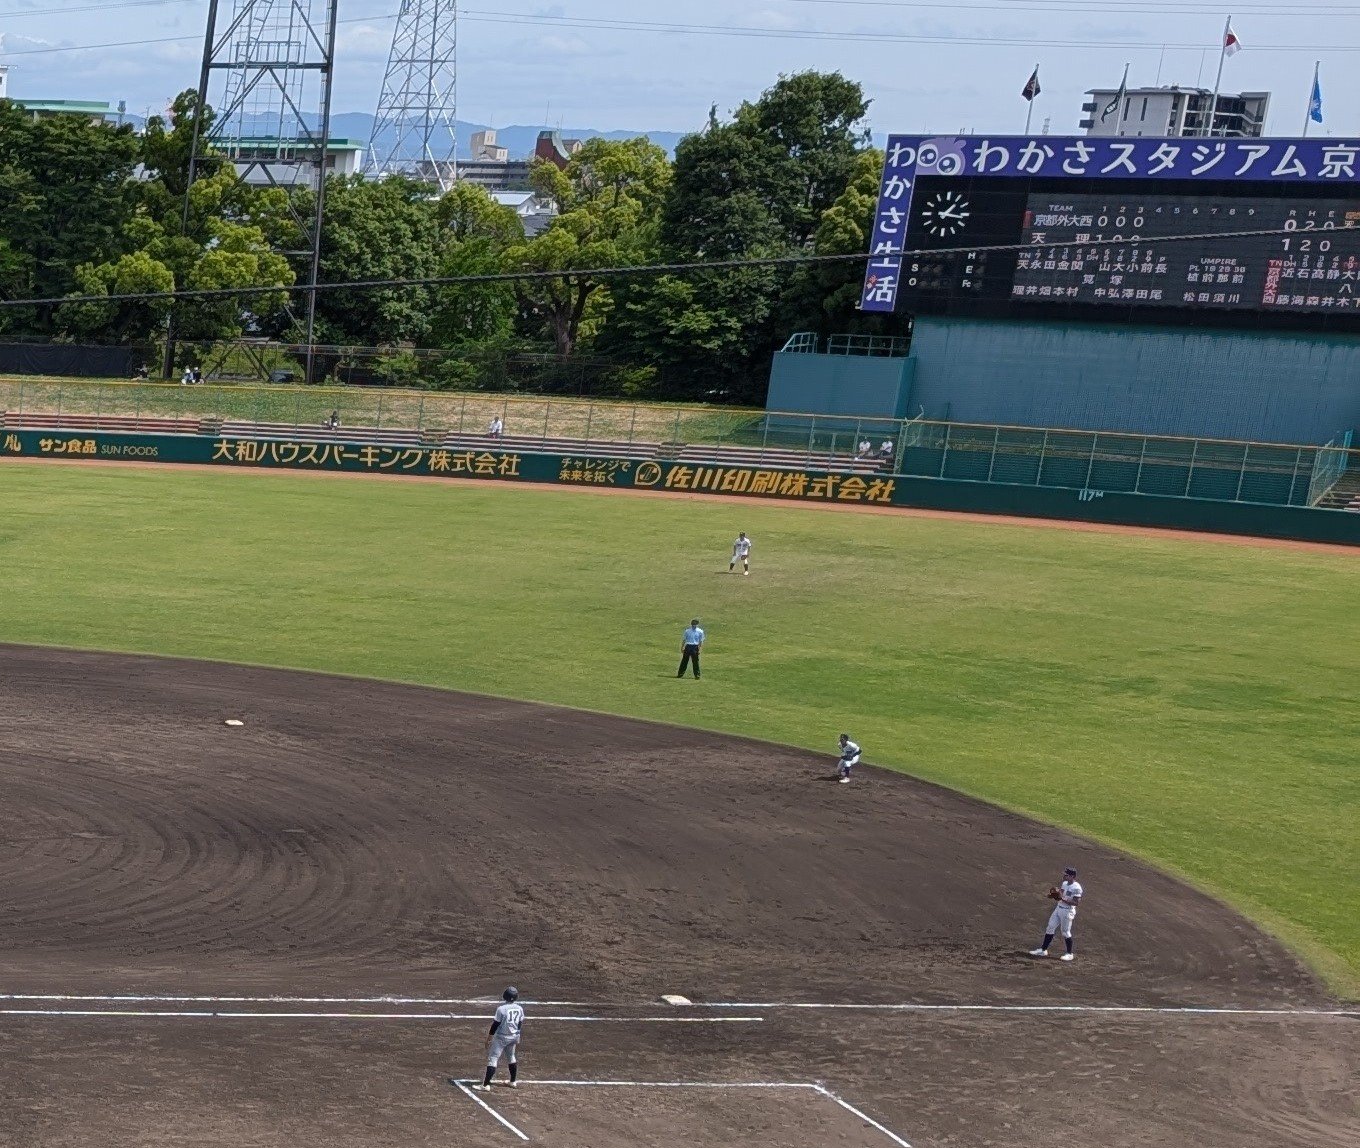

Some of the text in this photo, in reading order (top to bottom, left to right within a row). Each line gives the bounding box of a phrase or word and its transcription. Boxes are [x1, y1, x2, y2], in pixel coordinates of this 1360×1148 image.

[1049, 204, 1073, 212] TEAM
[867, 142, 915, 303] わかさ生活
[1034, 215, 1093, 227] 京都外大西
[1097, 216, 1108, 227] 0
[1116, 216, 1126, 227] 0
[1133, 216, 1144, 228] 0
[1284, 219, 1297, 231] 0
[1305, 220, 1315, 231] 2
[1281, 238, 1291, 250] 1
[1300, 240, 1311, 251] 2
[1319, 240, 1331, 251] 0
[911, 264, 973, 274] S E
[1200, 258, 1237, 266] UMPIRE
[909, 278, 917, 286] O
[39, 438, 158, 456] サン食品 SUN FOODS
[212, 439, 521, 475] 大和ハウスパーキング株式会社
[561, 457, 632, 473] チャレンジで
[666, 465, 896, 503] 佐川印刷株式会社
